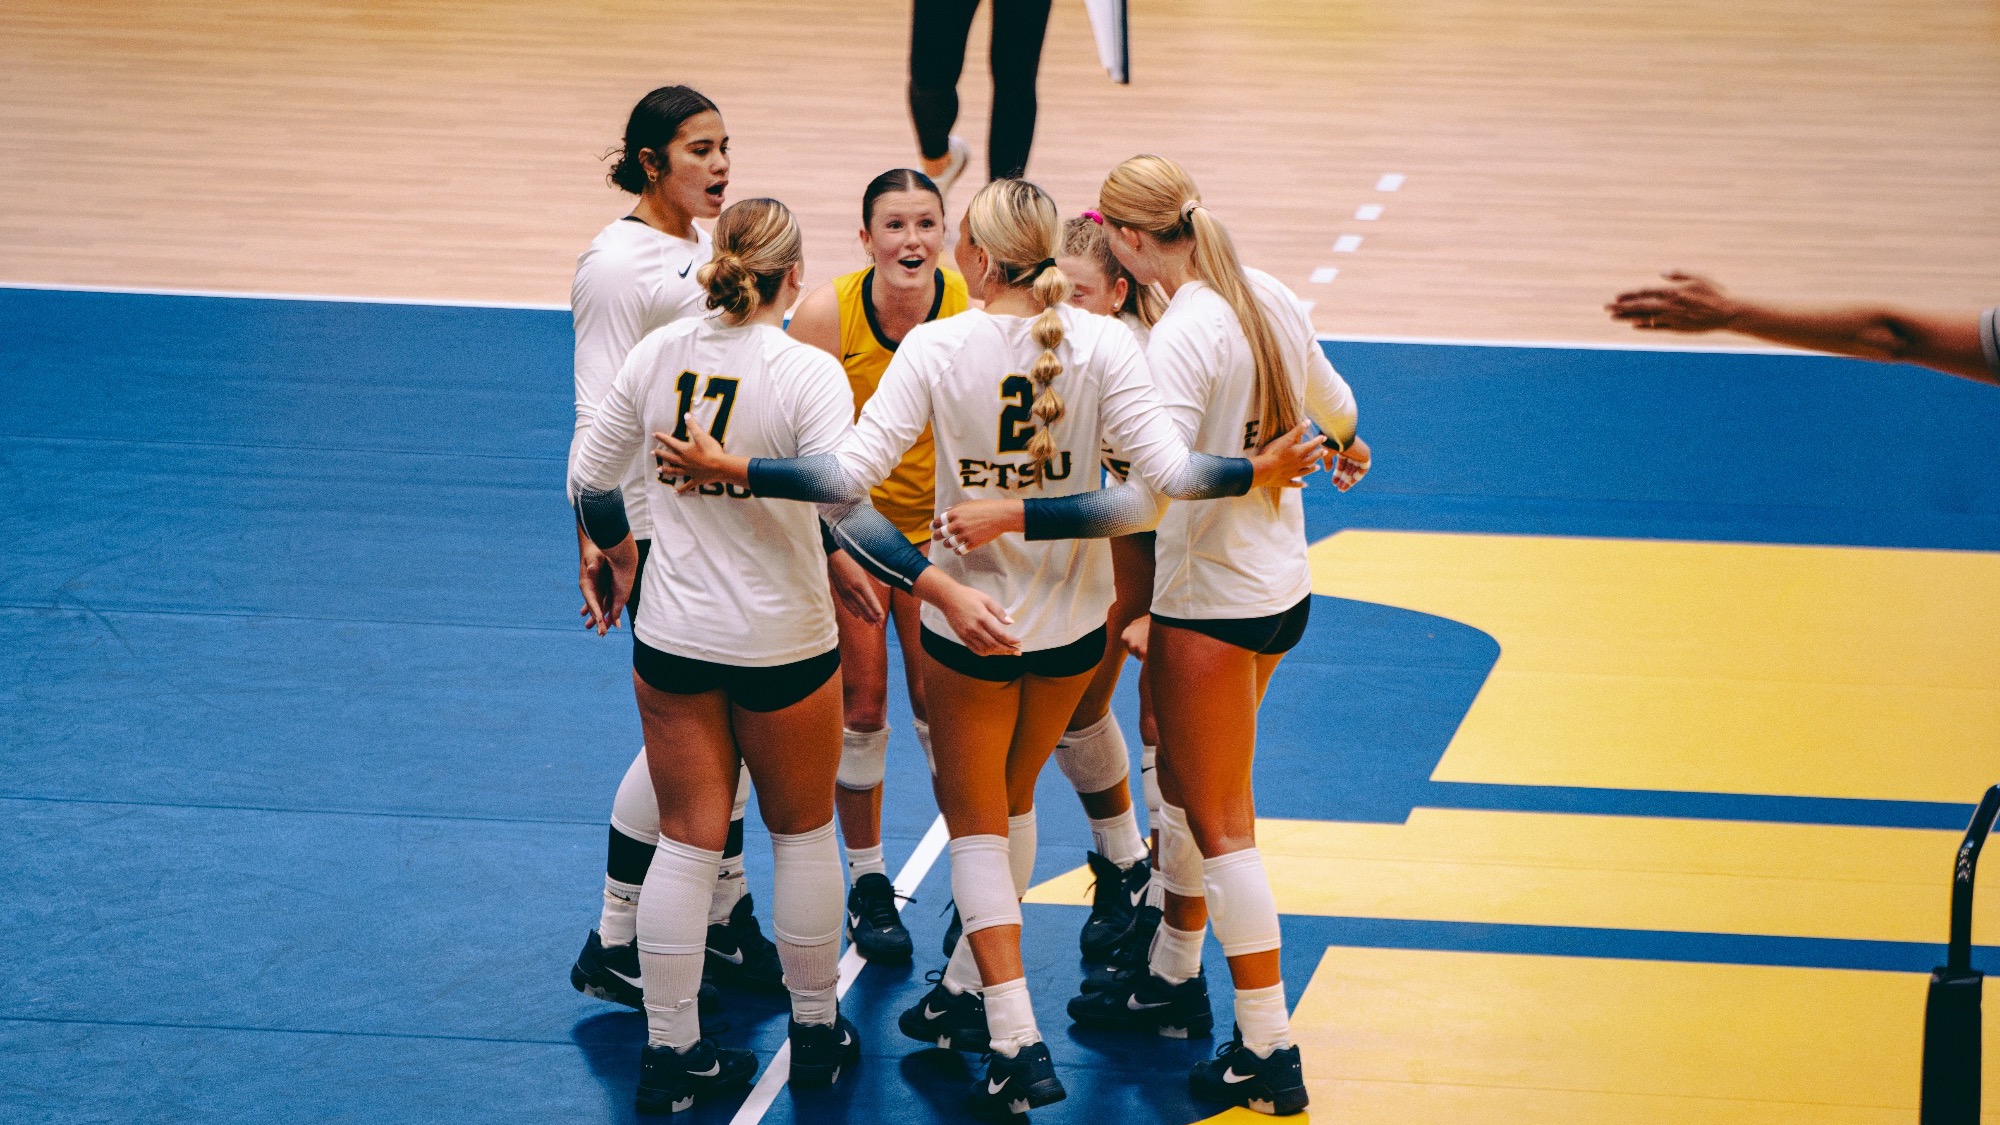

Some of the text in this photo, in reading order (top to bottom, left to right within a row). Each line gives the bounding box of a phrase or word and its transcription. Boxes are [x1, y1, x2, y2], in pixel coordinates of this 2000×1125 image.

[672, 370, 740, 449] 17
[997, 373, 1036, 455] 2
[958, 451, 1072, 490] ETSU
